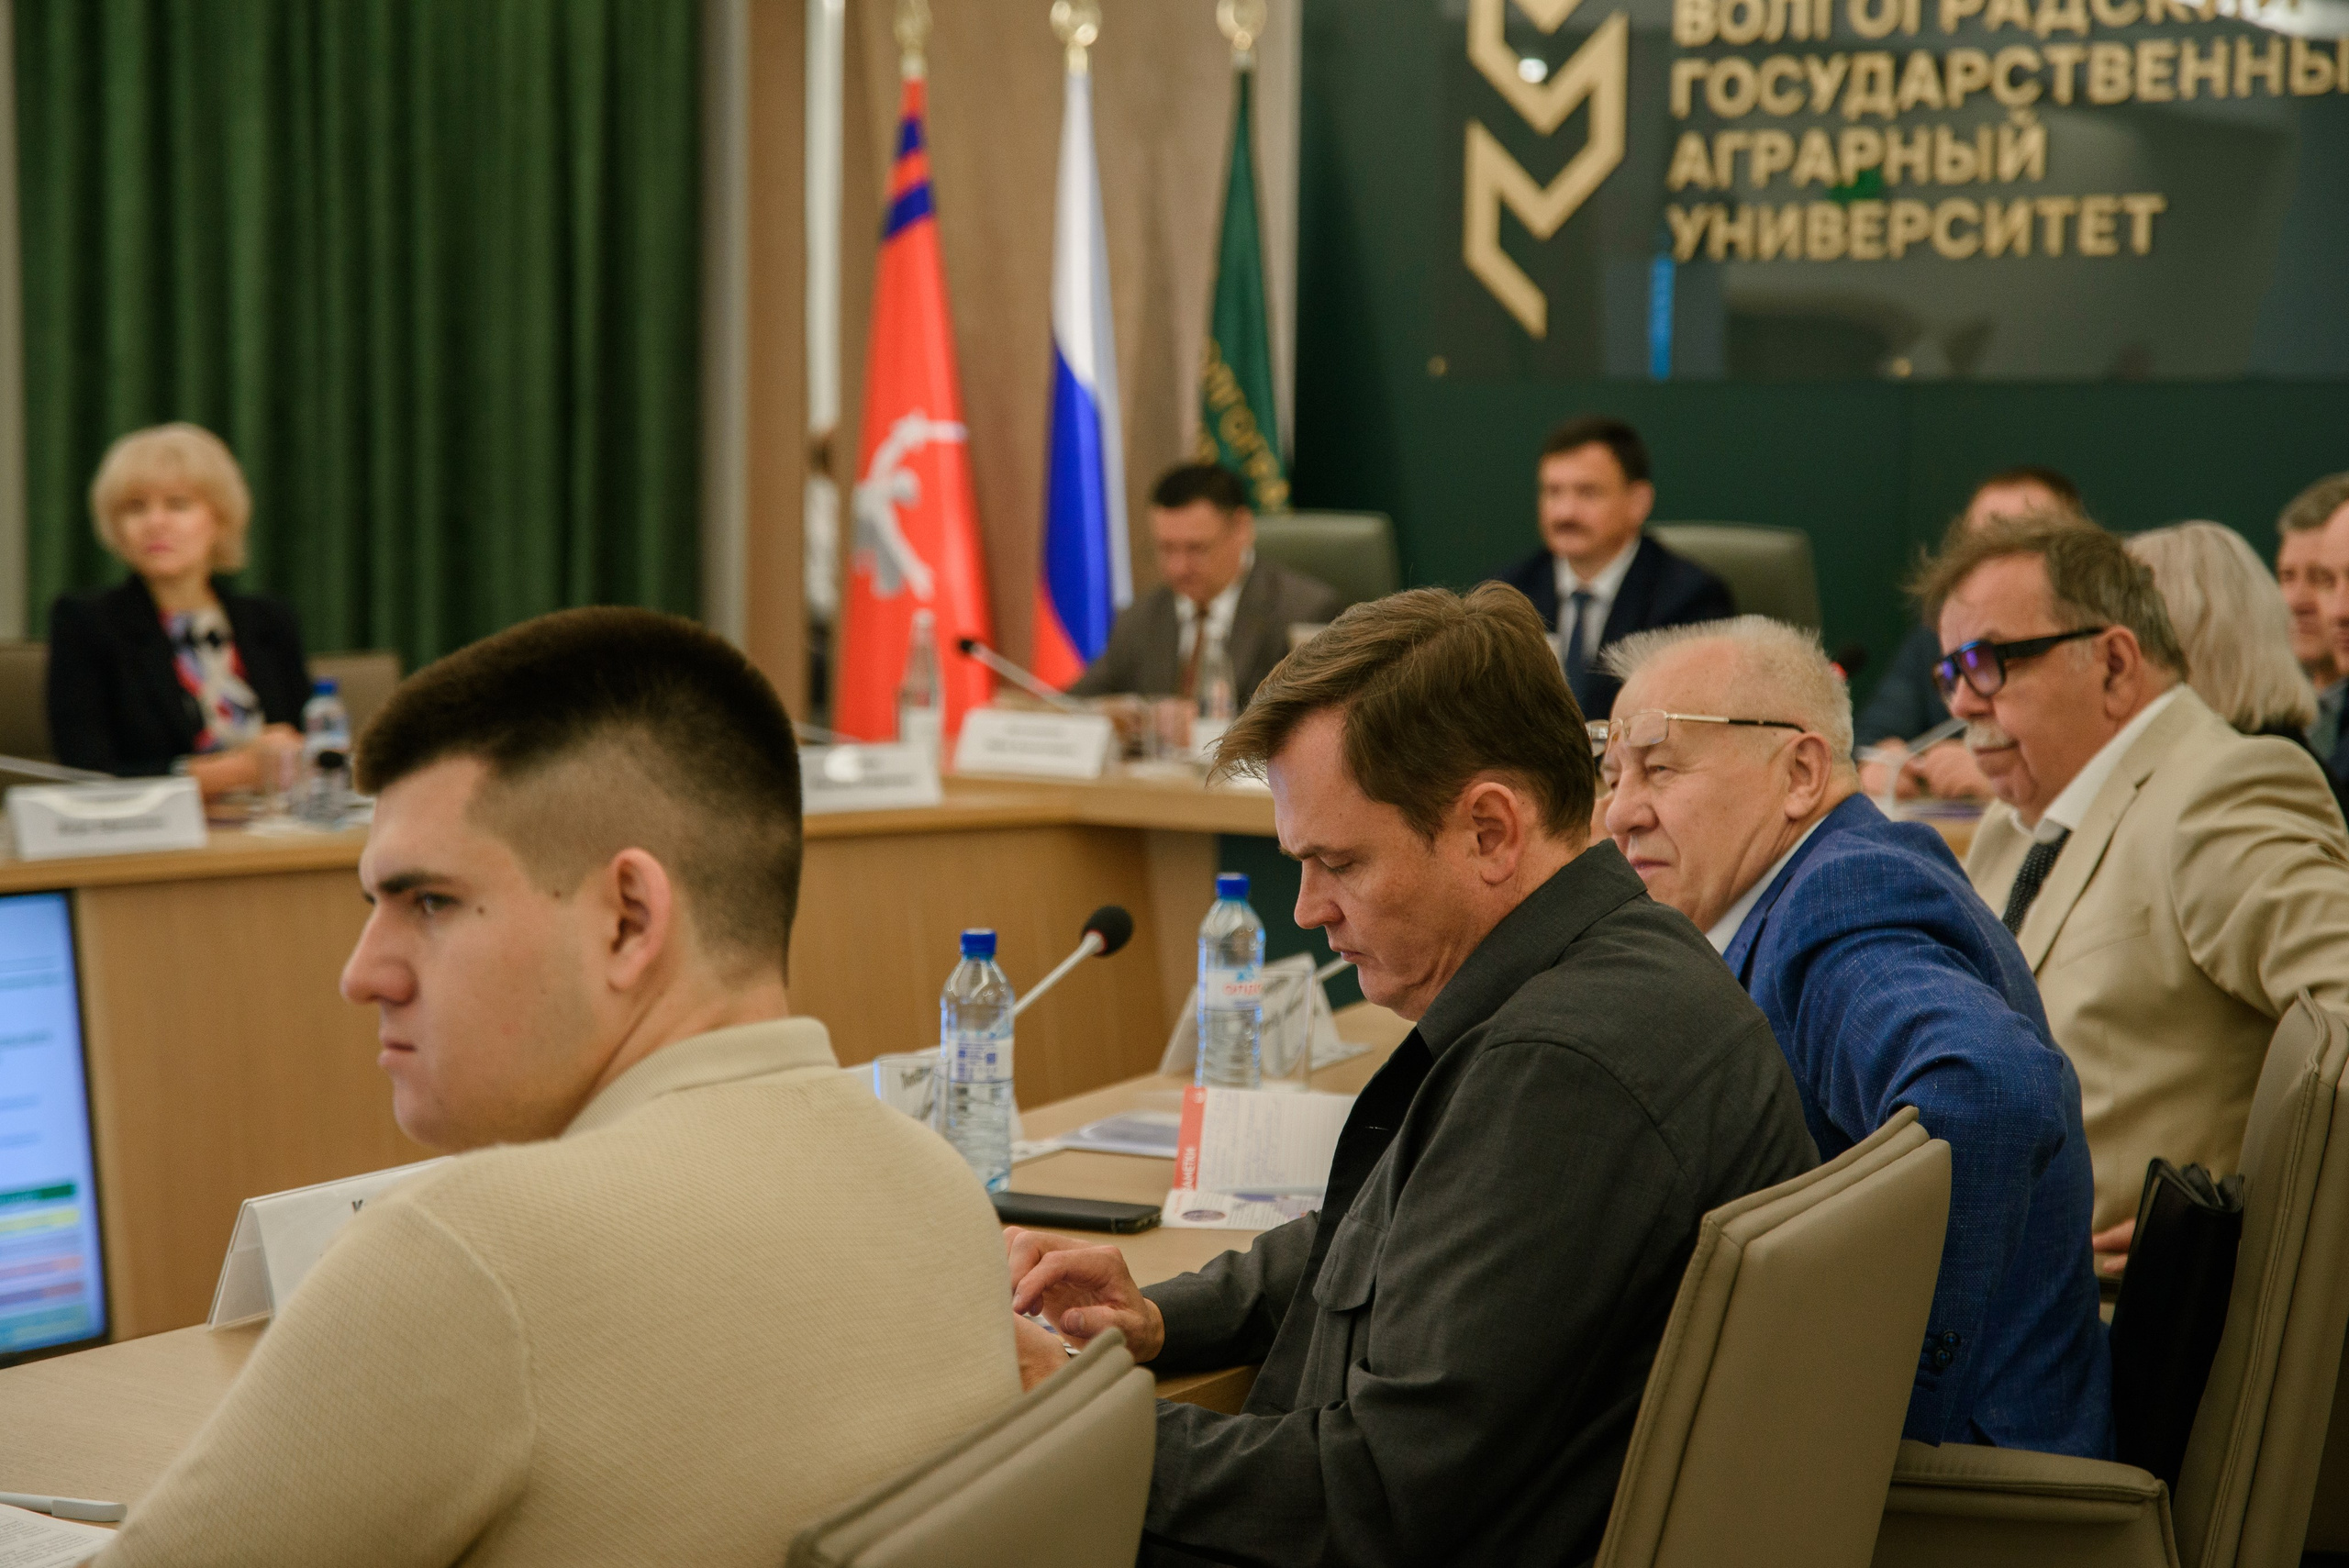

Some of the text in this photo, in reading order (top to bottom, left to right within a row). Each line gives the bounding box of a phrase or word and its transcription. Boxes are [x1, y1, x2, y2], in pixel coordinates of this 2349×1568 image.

[1672, 0, 2301, 46] ВОЛГОГРАД
[1667, 106, 2047, 188] АГРАРНЫЙ
[1666, 194, 2166, 262] УНИВЕРСИТЕТ
